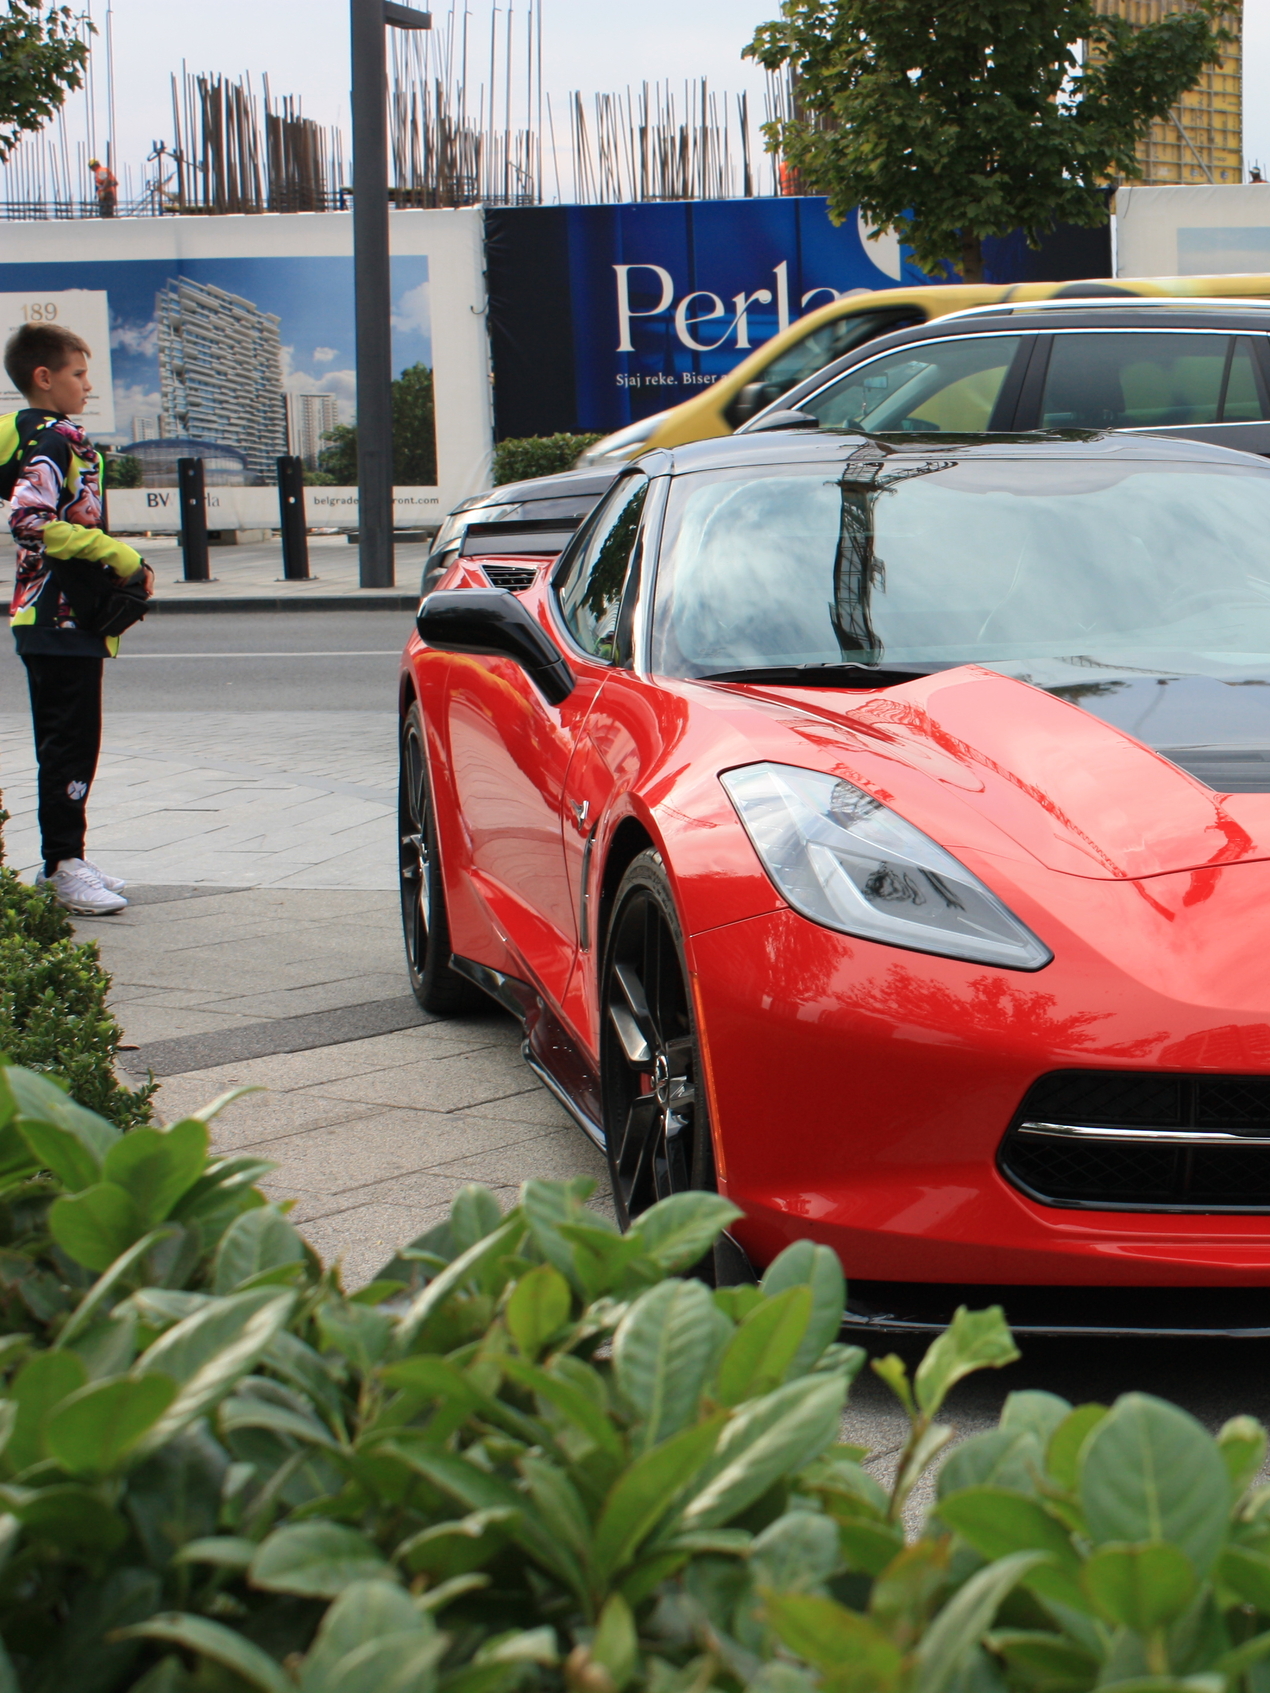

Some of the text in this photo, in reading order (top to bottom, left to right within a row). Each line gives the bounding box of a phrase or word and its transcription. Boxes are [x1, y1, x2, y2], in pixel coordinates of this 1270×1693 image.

[616, 373, 641, 388] Sjaj
[645, 372, 678, 385] reke.
[683, 372, 717, 384] Biser
